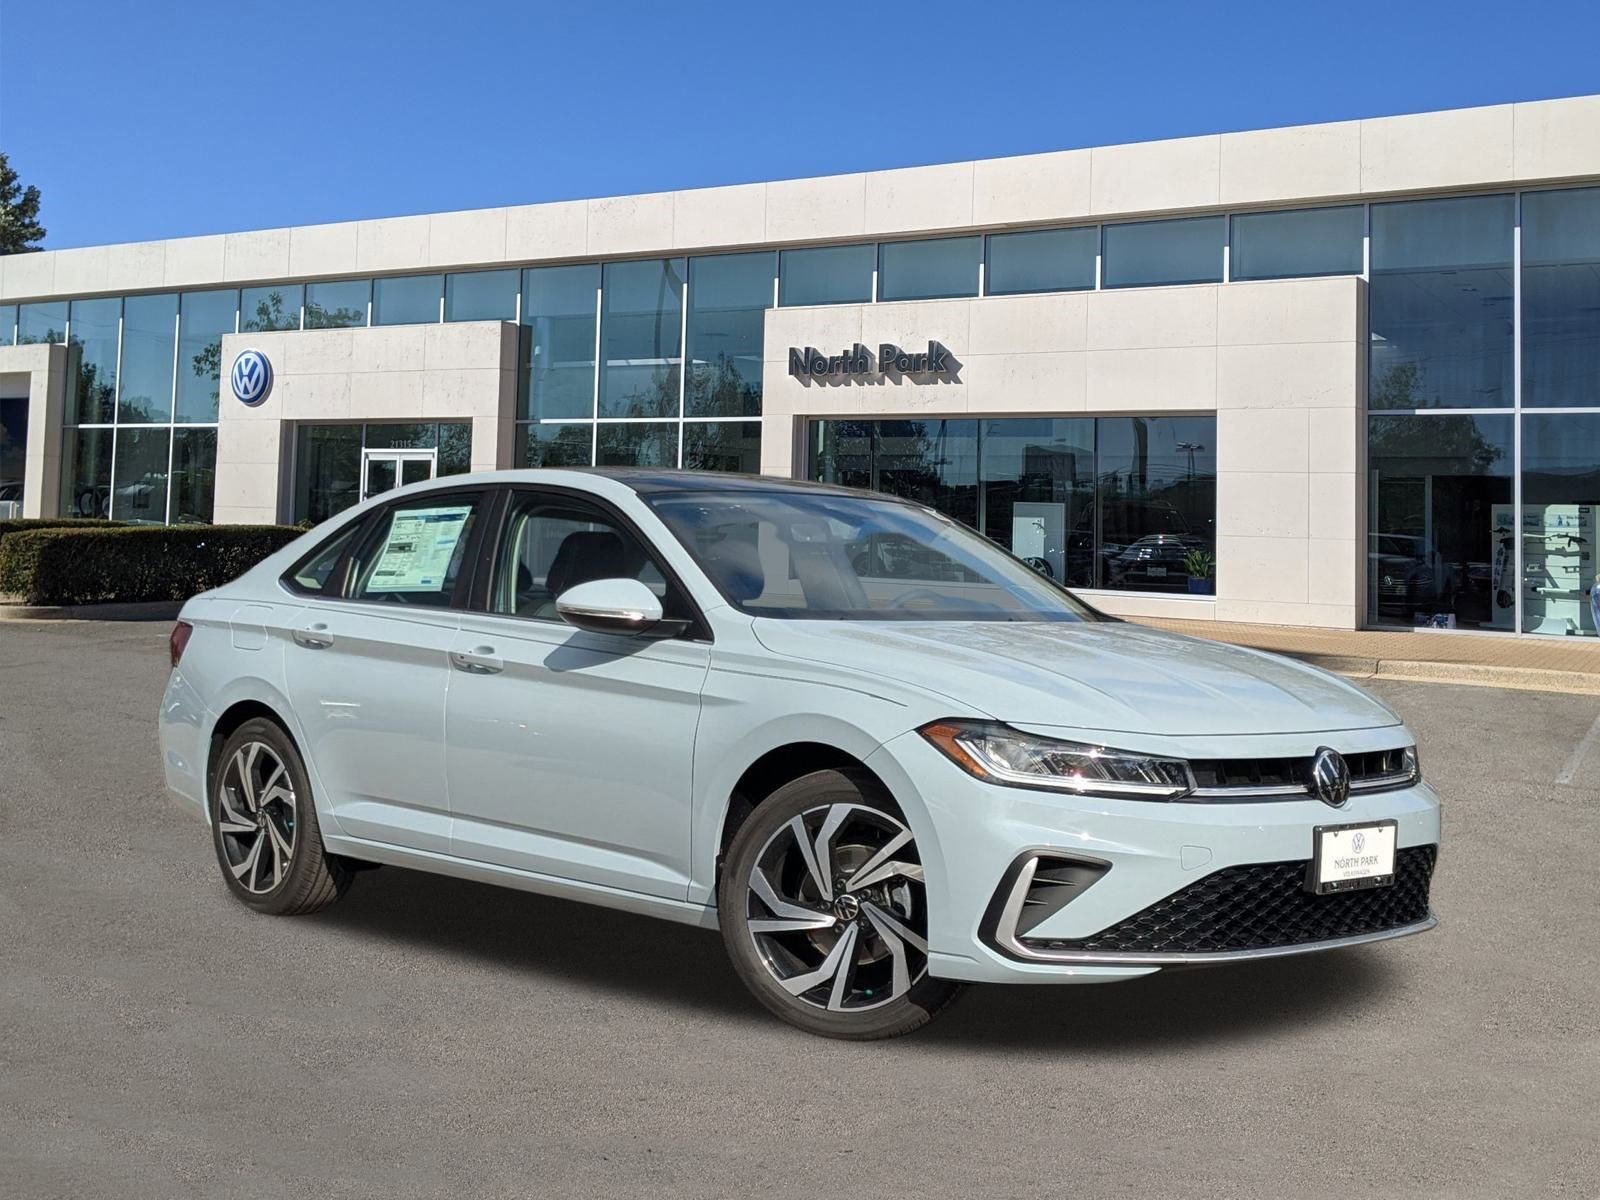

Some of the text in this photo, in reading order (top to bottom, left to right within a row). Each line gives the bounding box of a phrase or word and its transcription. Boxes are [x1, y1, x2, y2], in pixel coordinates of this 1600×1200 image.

[232, 351, 268, 402] VW
[789, 340, 947, 377] North Park
[1334, 855, 1379, 869] NORTH PARK
